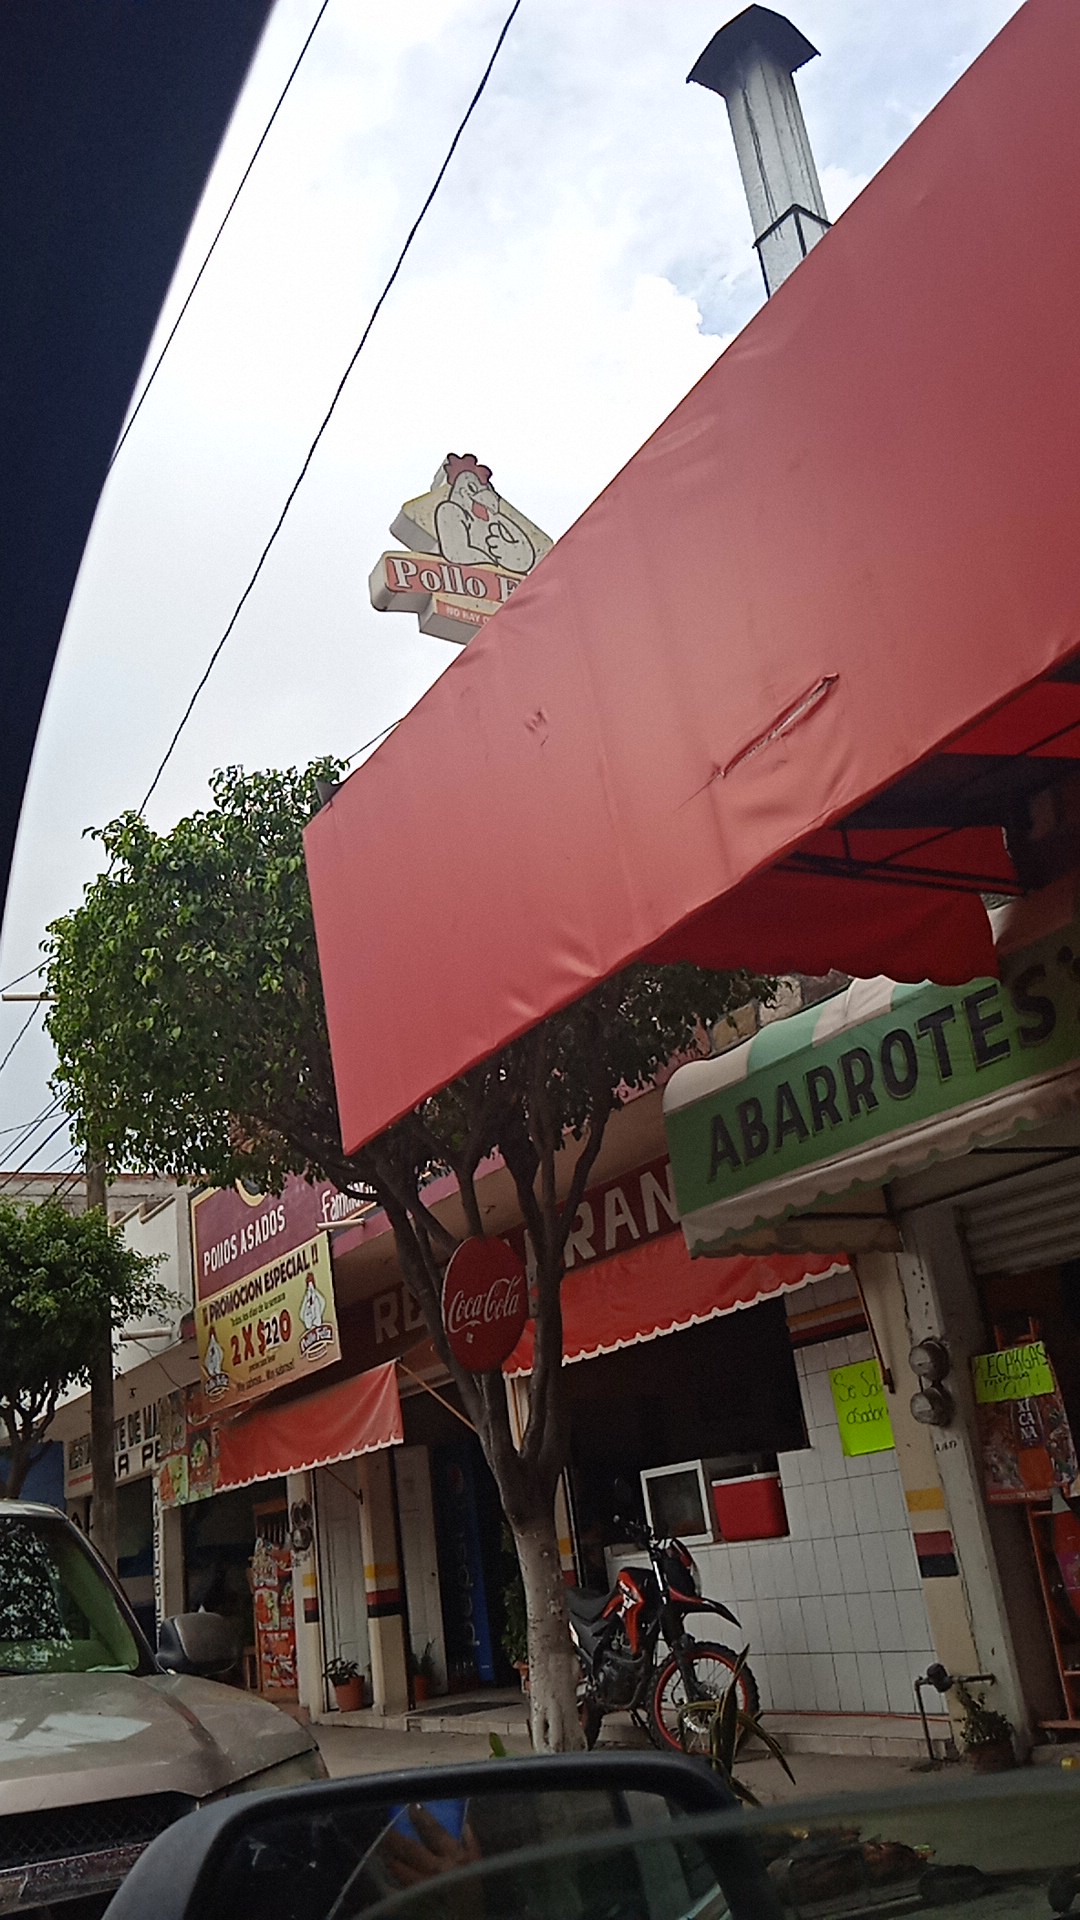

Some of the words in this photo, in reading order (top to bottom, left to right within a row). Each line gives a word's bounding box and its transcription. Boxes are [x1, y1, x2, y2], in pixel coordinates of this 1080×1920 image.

[391, 559, 487, 599] Pollo
[707, 965, 1057, 1184] ABARROTES
[240, 1205, 286, 1256] ASADOS
[264, 1250, 310, 1293] ESPECIAL
[449, 1275, 522, 1334] Coca-Cola
[230, 1335, 242, 1367] 2
[257, 1309, 291, 1357] $220
